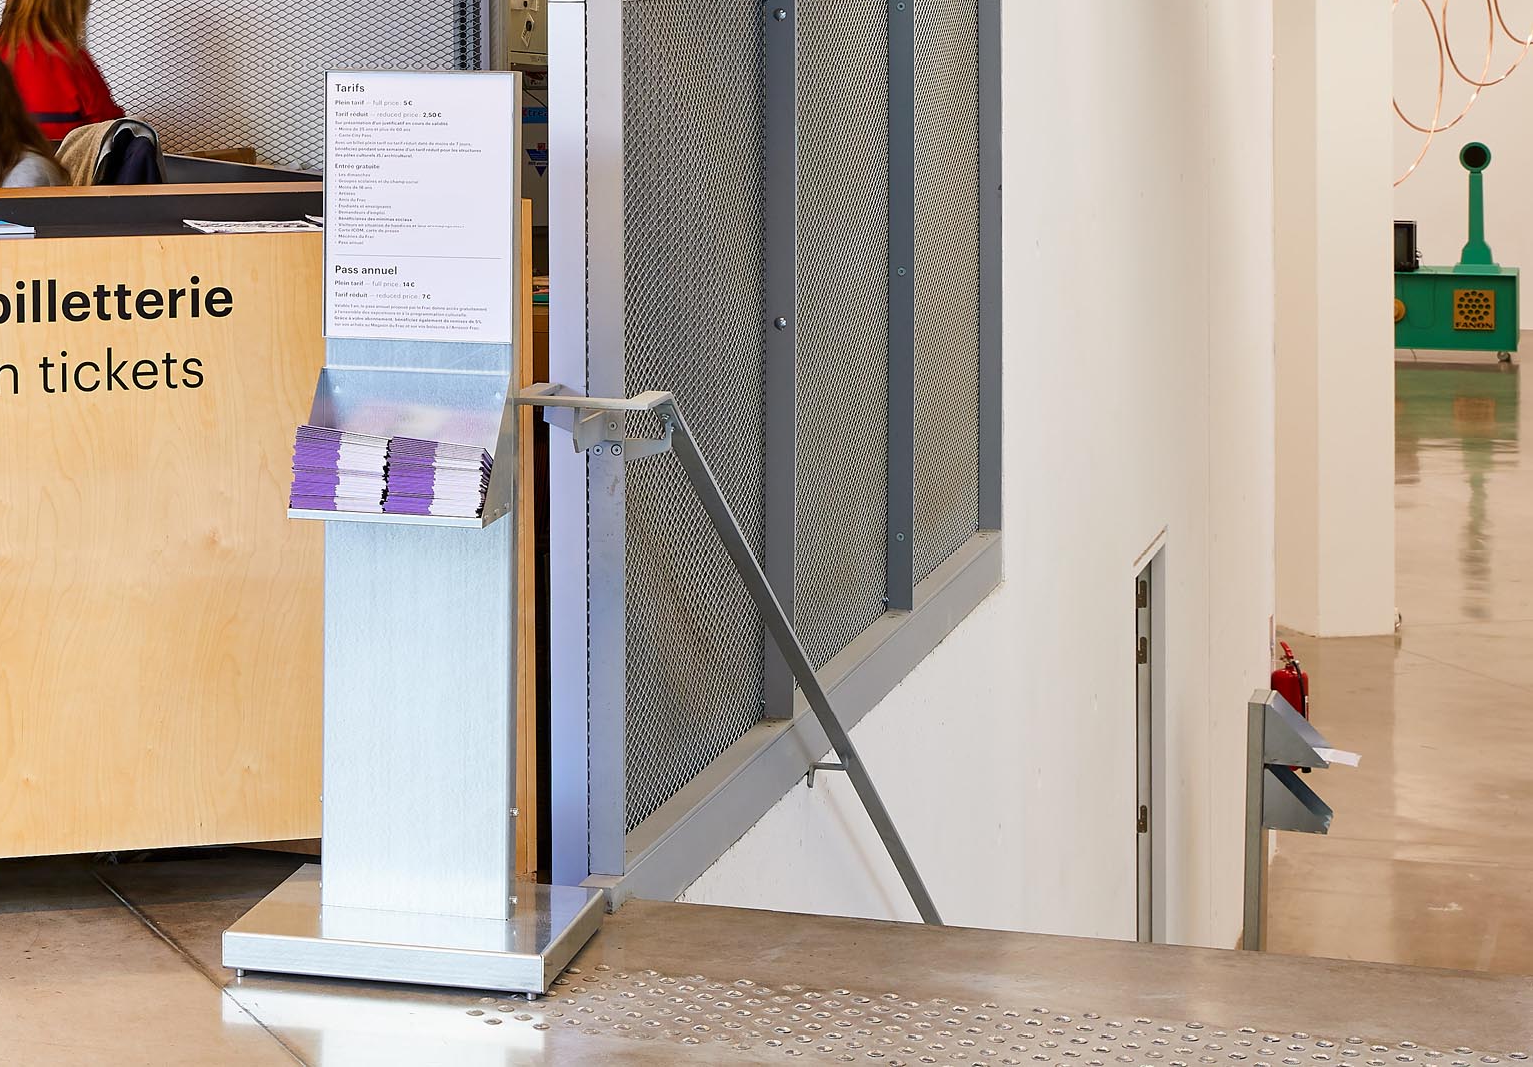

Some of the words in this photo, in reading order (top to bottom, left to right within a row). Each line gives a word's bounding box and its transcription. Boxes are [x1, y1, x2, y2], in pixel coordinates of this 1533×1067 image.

[335, 83, 365, 92] Tarifs
[335, 265, 358, 274] Pass
[362, 266, 397, 275] annuel
[39, 347, 205, 396] tickets
